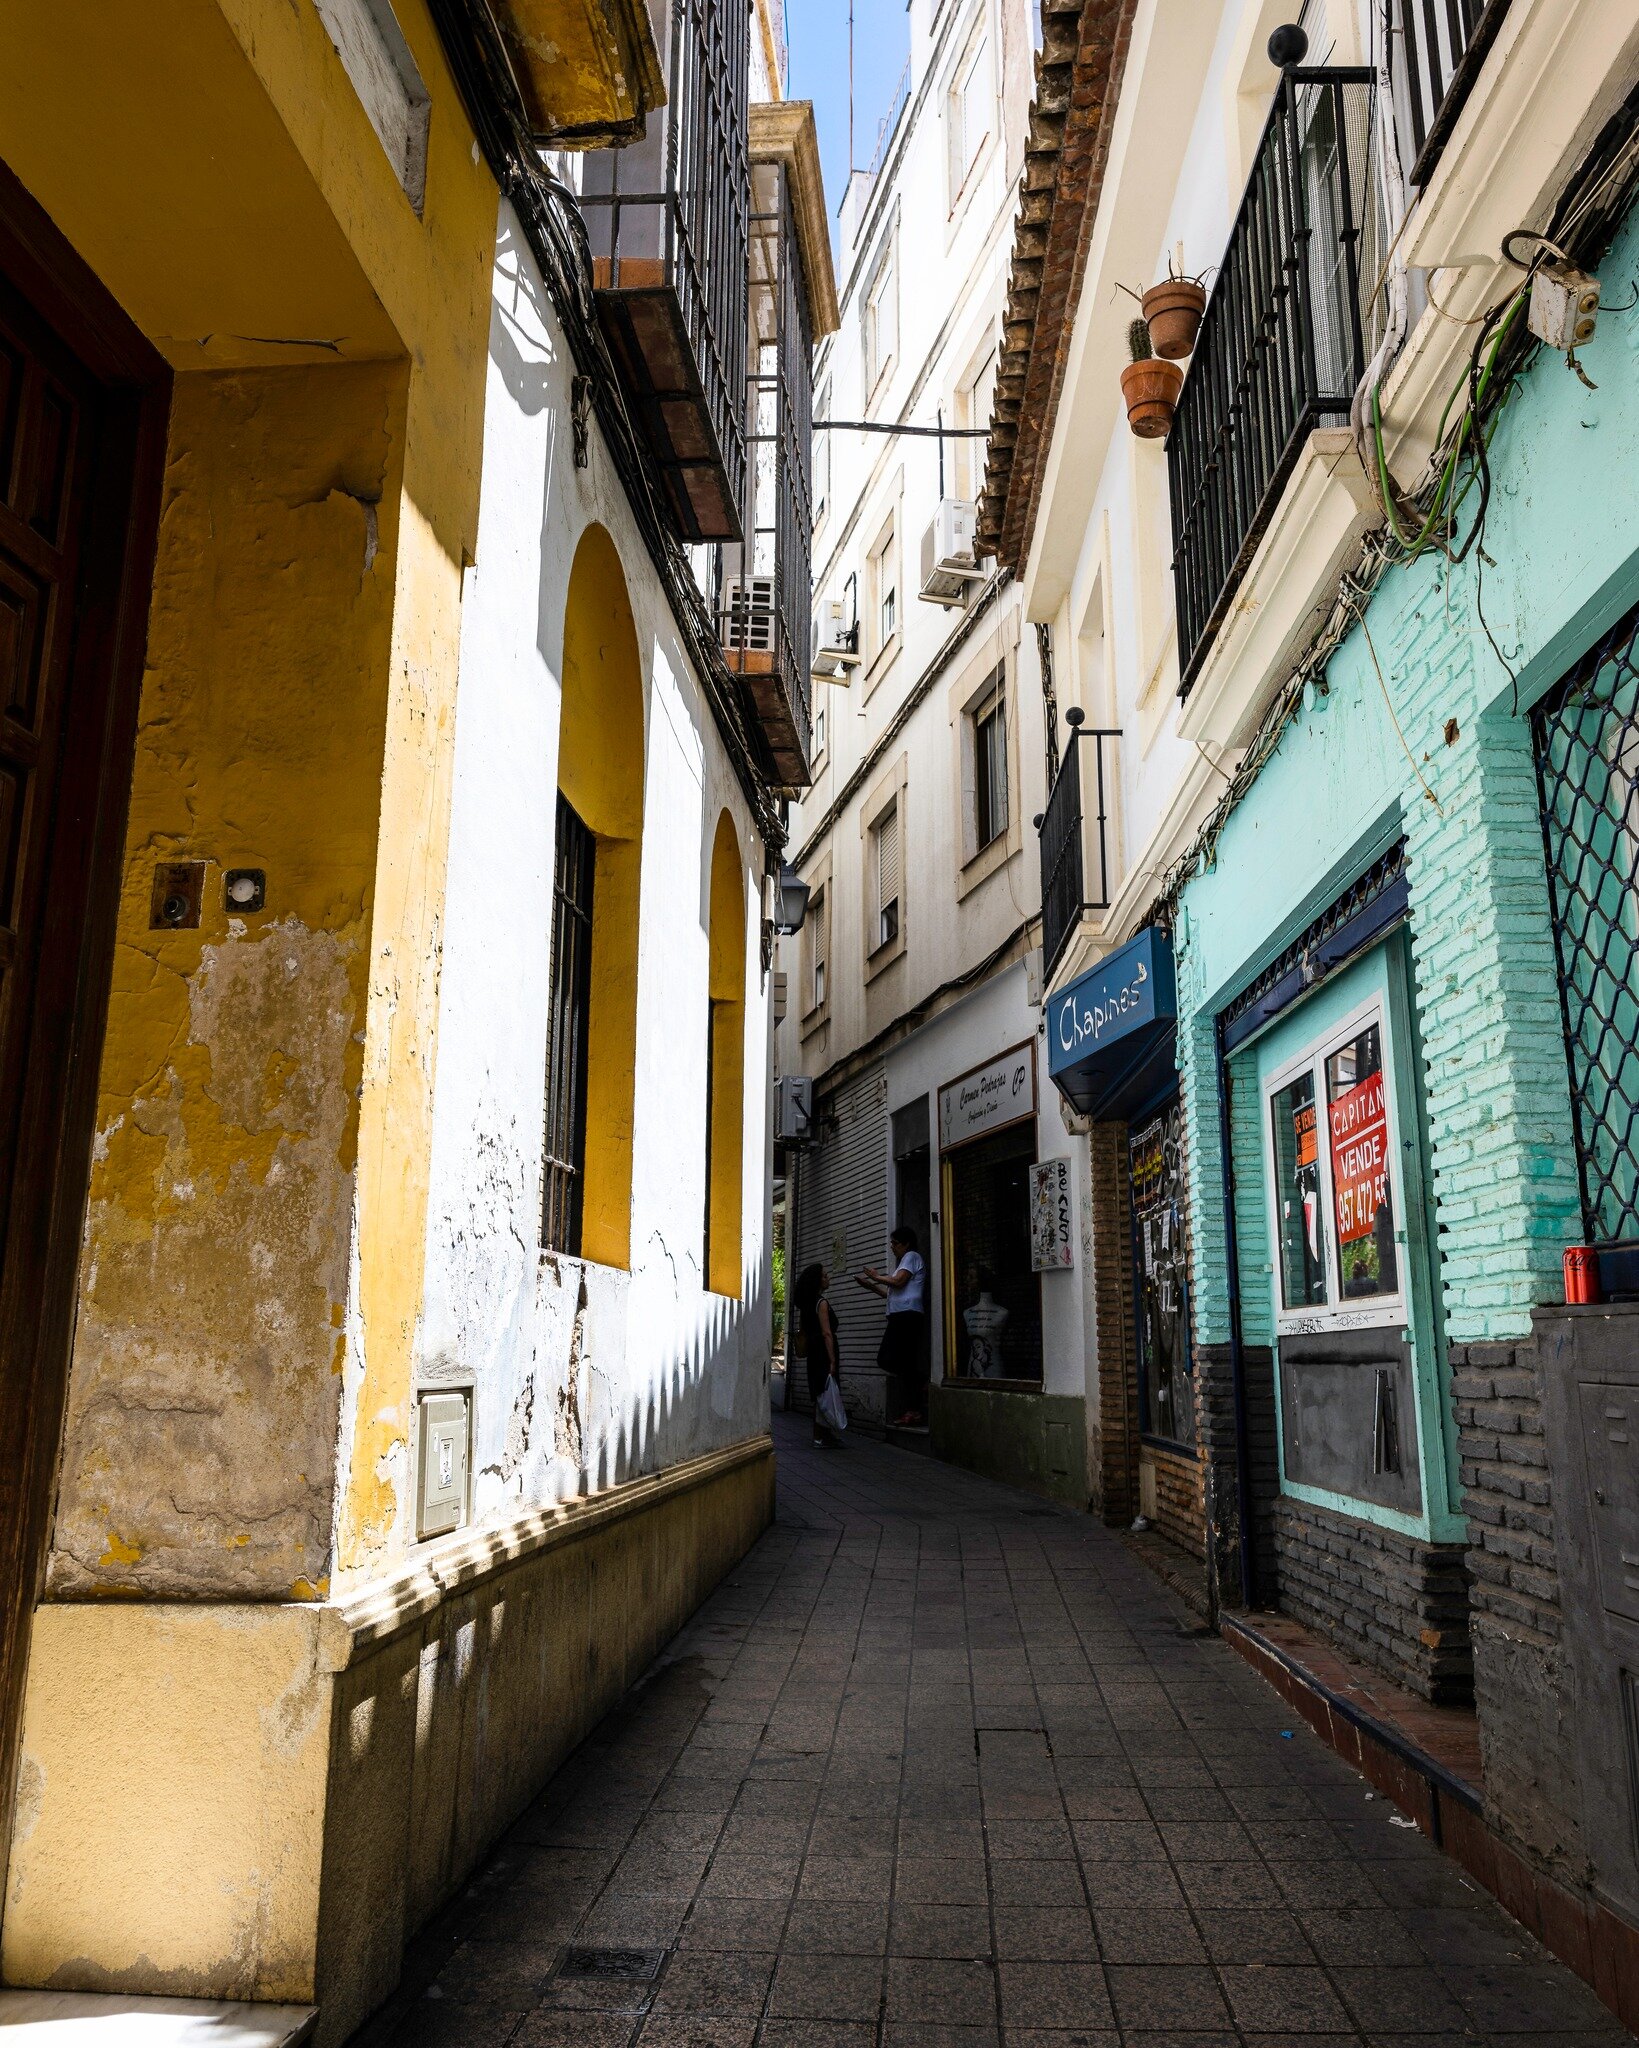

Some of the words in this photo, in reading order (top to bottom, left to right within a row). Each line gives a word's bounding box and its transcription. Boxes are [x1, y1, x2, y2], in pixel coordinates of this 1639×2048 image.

[1060, 963, 1147, 1050] Chapines
[1012, 1065, 1026, 1097] CP
[1333, 1083, 1385, 1136] CAPITAN
[1341, 1135, 1381, 1179] VENDE
[1339, 1188, 1354, 1234] 957
[1357, 1180, 1374, 1226] 472
